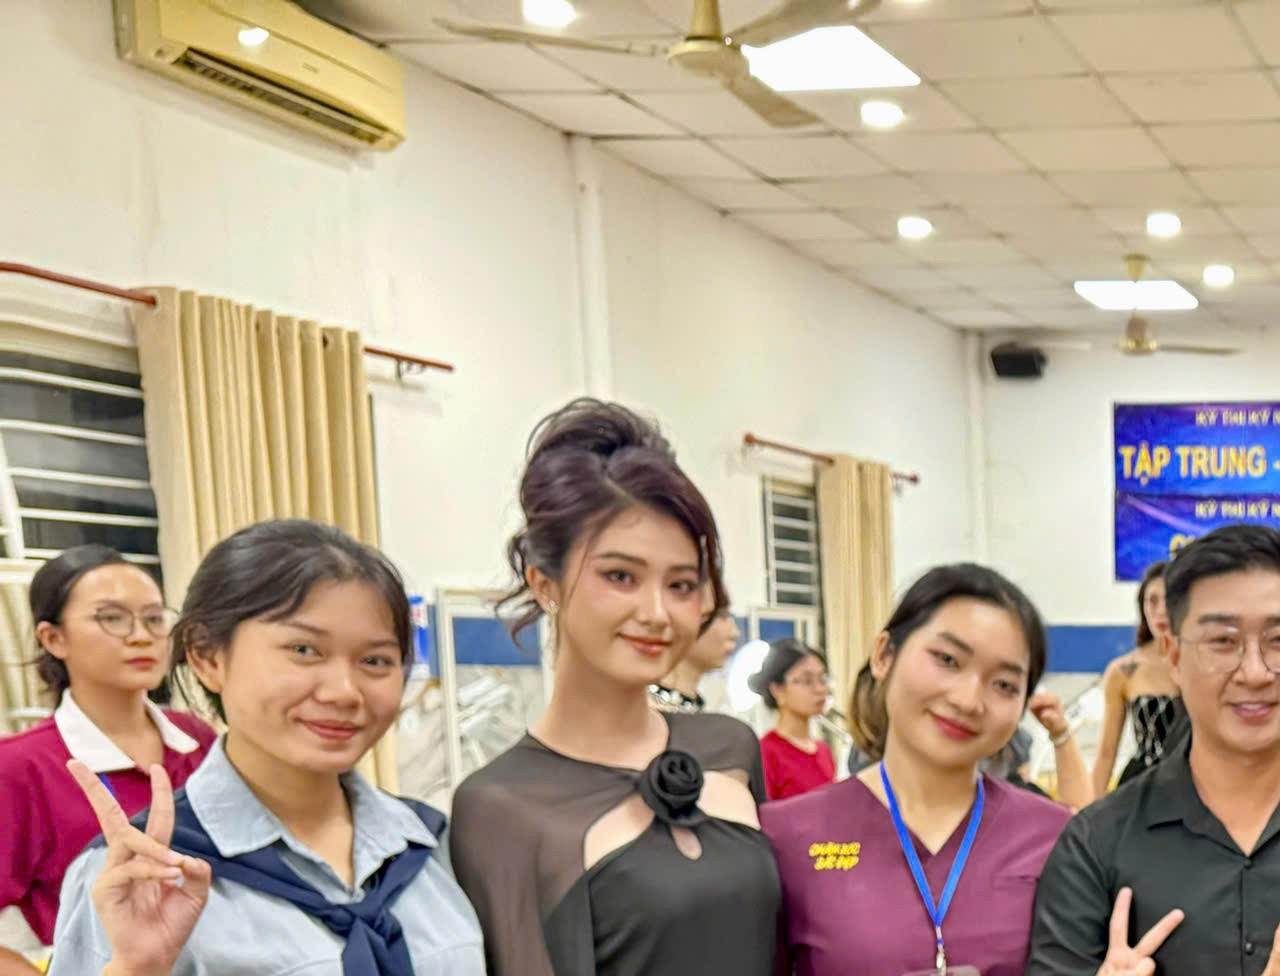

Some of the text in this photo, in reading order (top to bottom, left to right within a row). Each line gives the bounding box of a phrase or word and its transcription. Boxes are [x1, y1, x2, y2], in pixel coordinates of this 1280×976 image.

[1222, 410, 1245, 425] THI
[1119, 441, 1171, 486] TẬP
[1175, 445, 1267, 478] TRUNG
